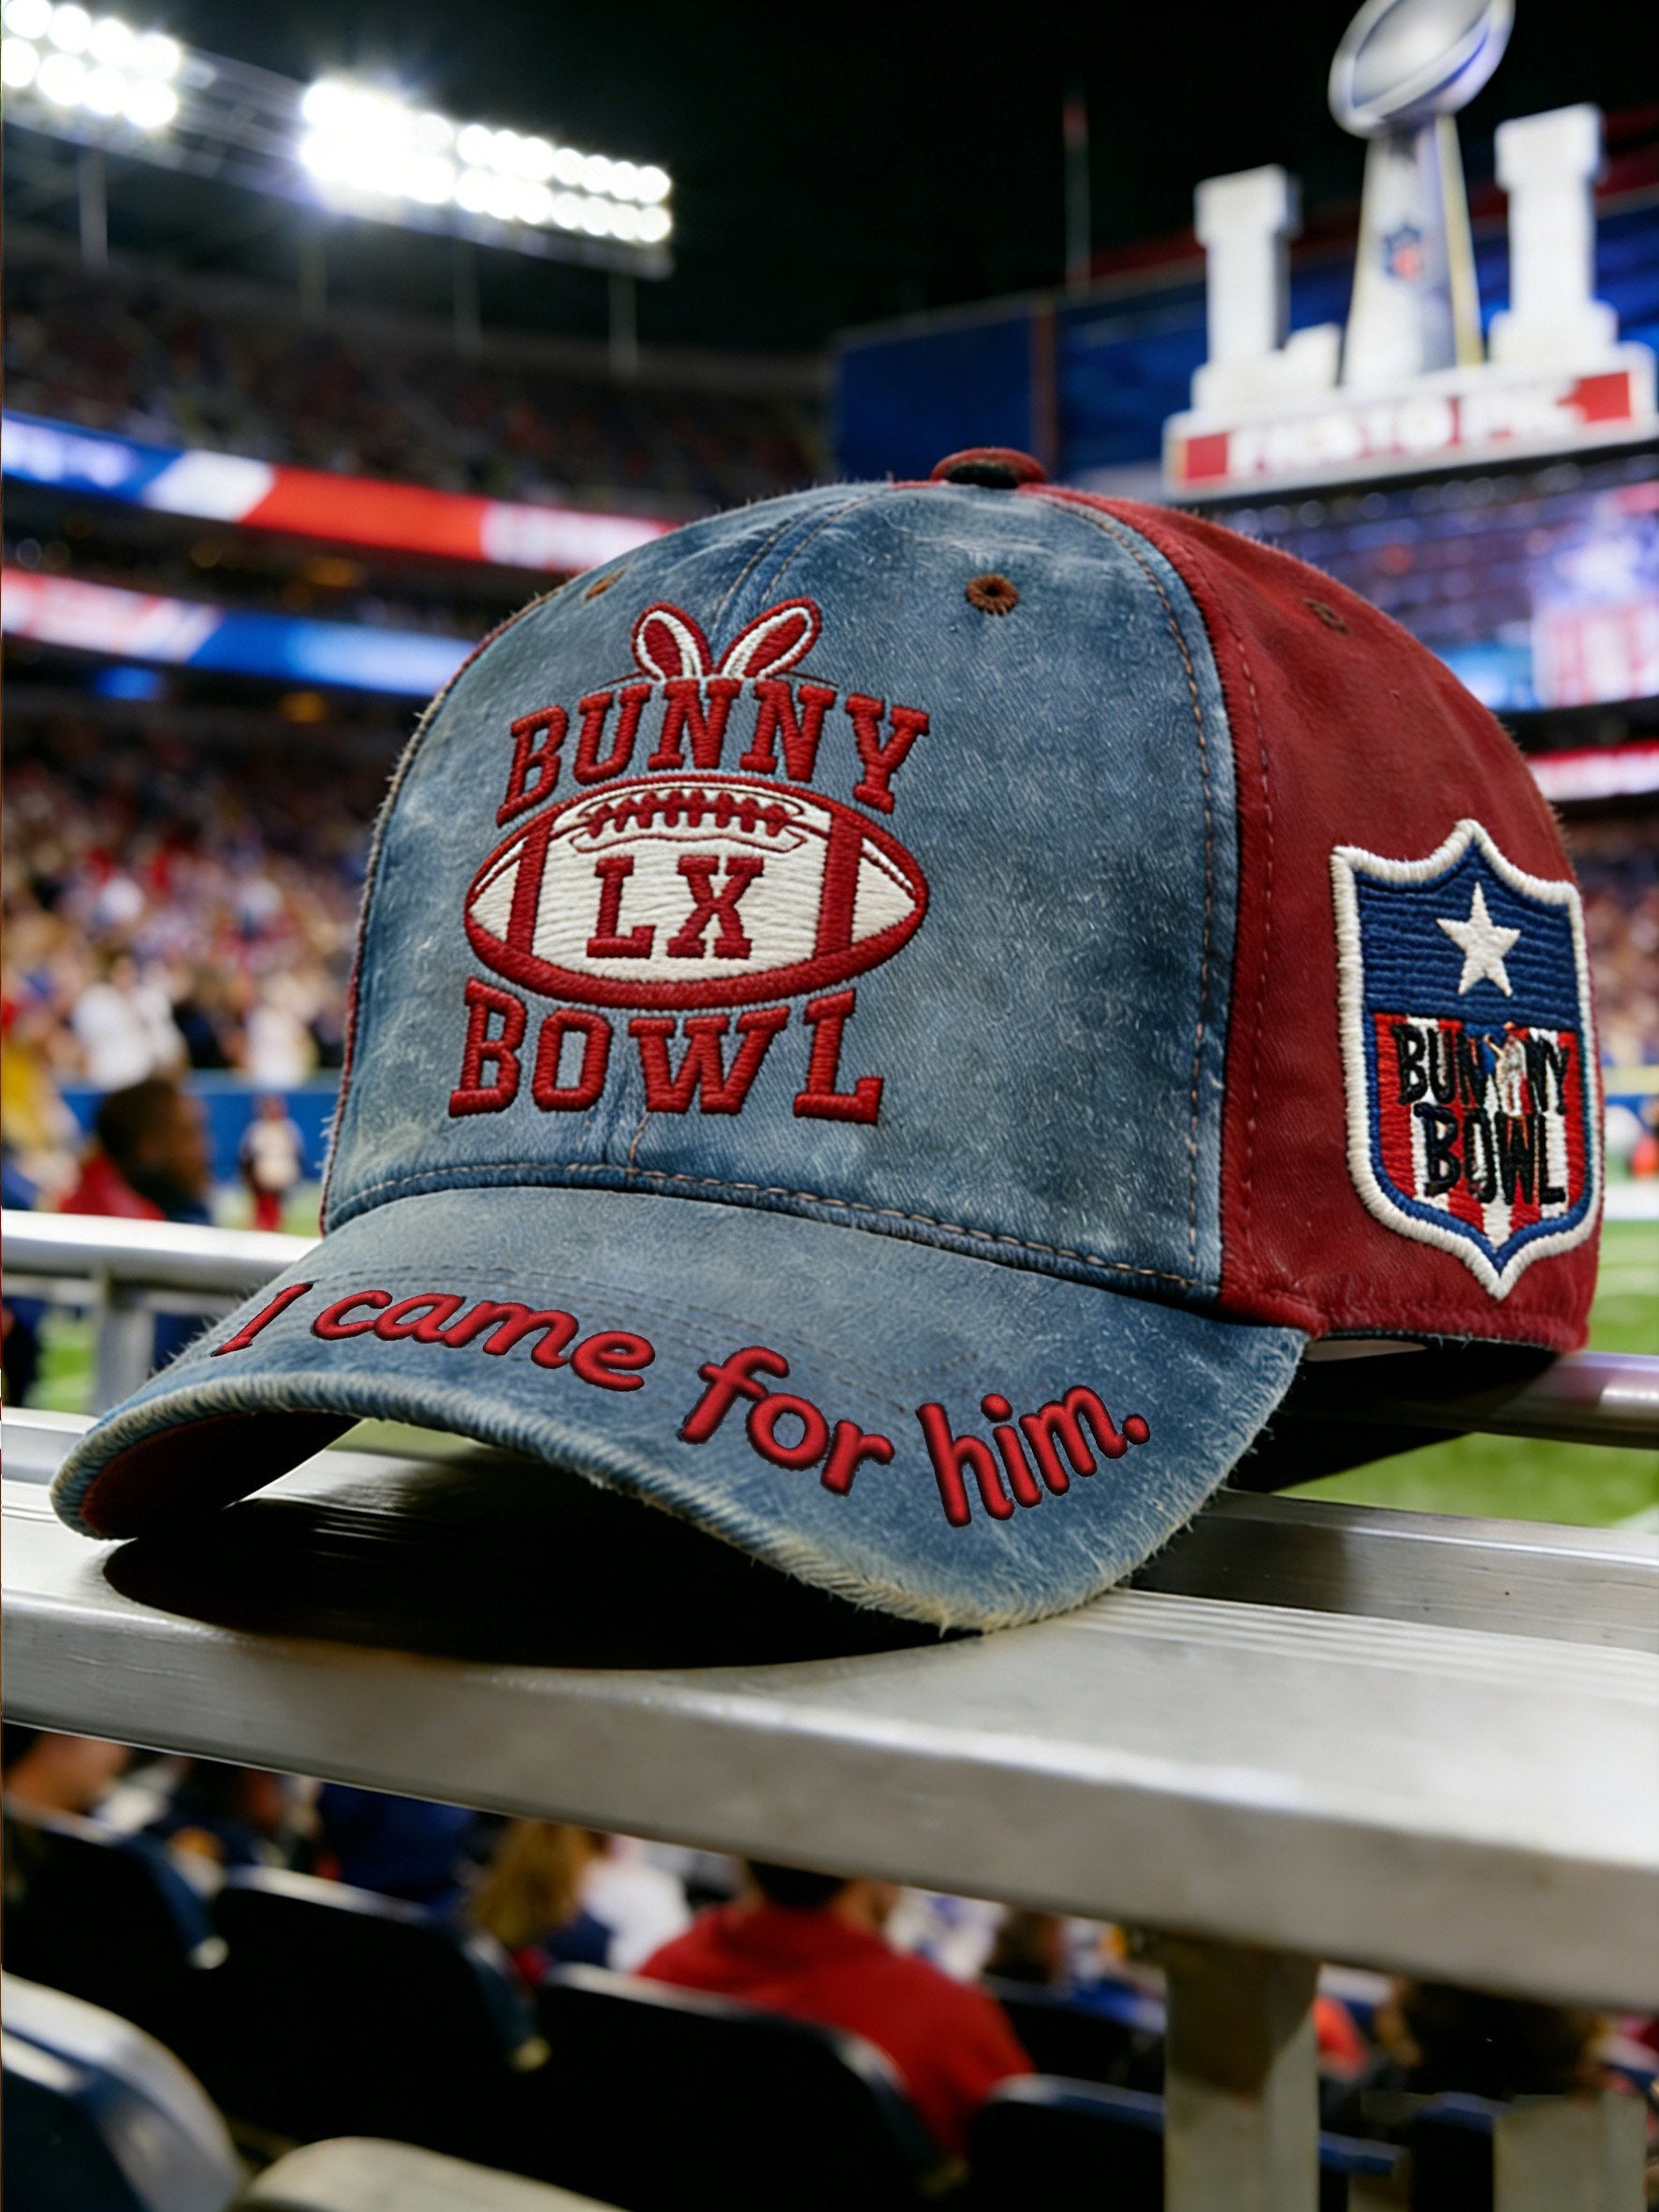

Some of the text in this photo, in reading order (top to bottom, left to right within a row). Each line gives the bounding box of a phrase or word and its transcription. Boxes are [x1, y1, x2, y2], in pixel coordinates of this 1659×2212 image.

[497, 677, 930, 828] BUNNY
[586, 855, 764, 959] LX
[448, 977, 883, 1124] BOWL
[1413, 1102, 1565, 1205] BOWL
[212, 1282, 1151, 1528] I came for him.
